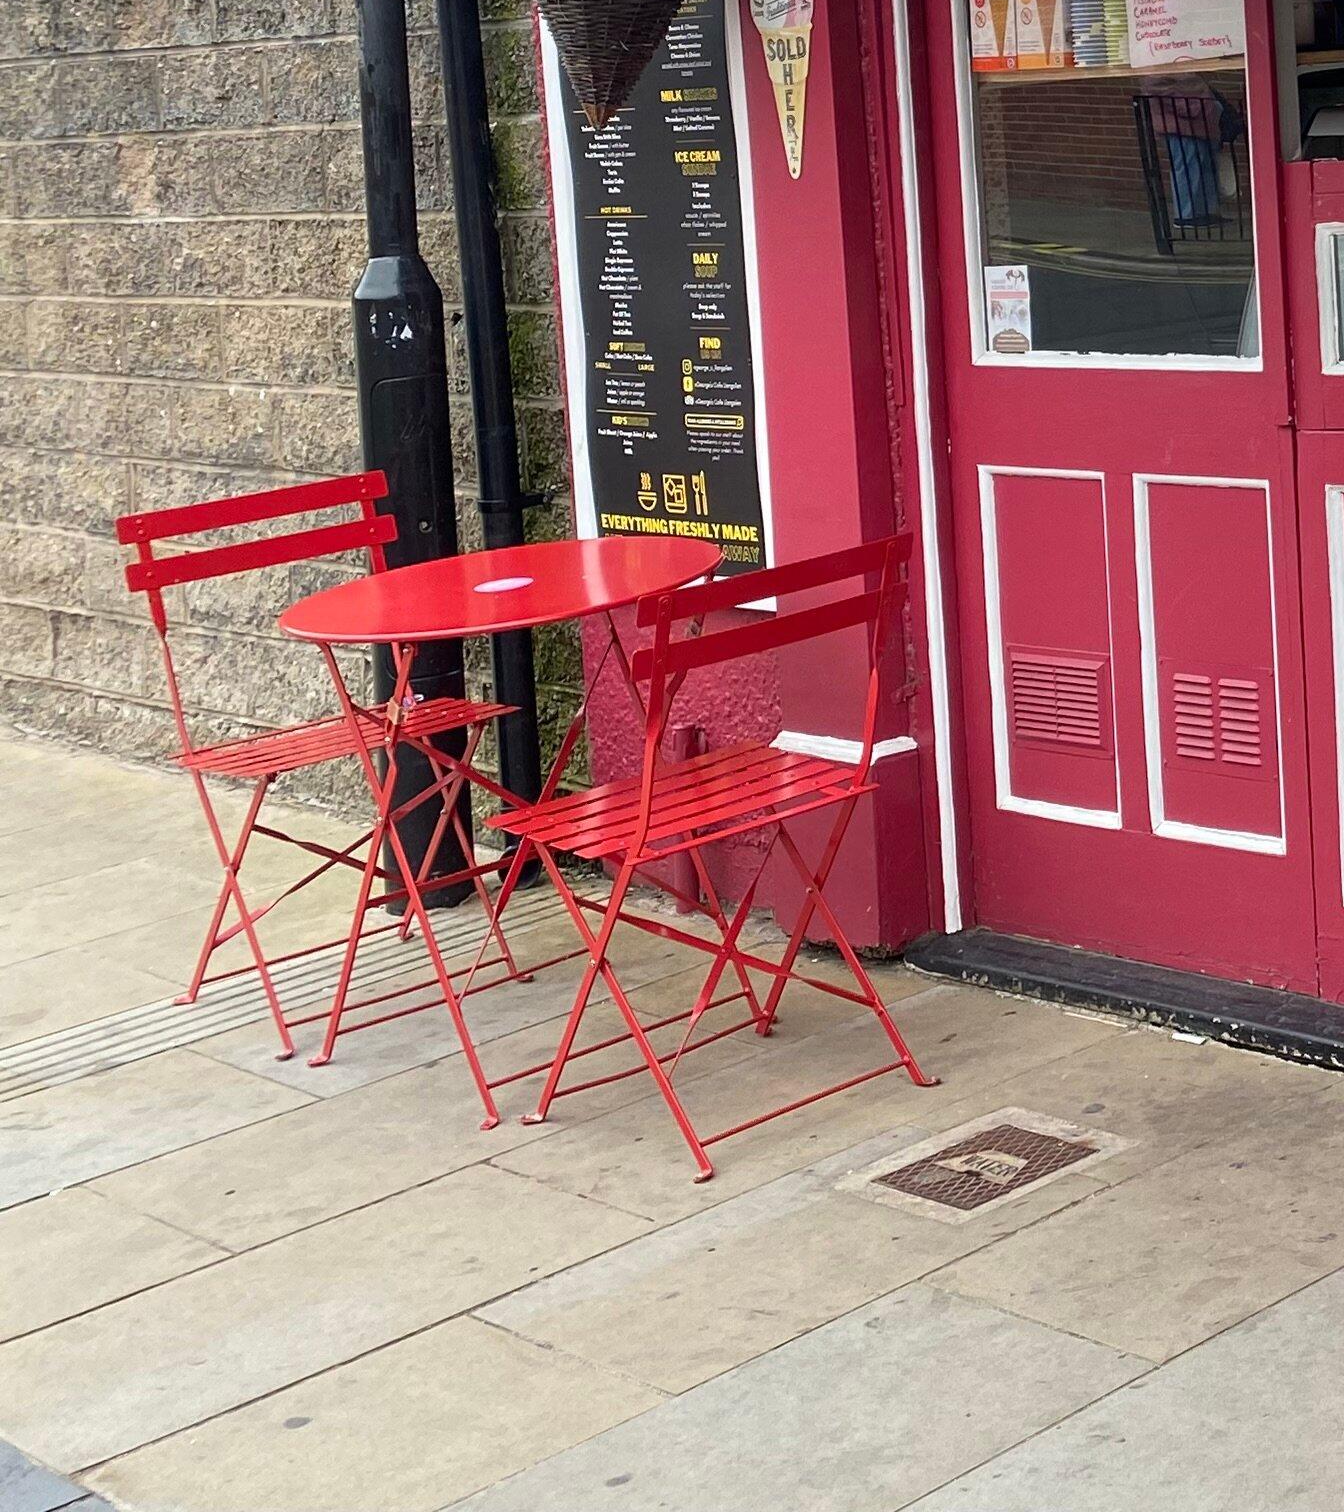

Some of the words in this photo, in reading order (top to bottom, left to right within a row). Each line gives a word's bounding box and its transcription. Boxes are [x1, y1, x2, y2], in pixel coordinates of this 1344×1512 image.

[1133, 6, 1167, 18] CARAMEL
[767, 36, 806, 62] SOLD
[660, 89, 682, 102] MILK
[674, 151, 689, 163] ICE
[690, 150, 721, 163] CREAM
[692, 253, 718, 264] DAILY
[699, 337, 721, 349] FIND
[601, 513, 668, 535] EVERYTHING
[669, 520, 720, 539] FRESHLY
[722, 524, 759, 542] MADE
[960, 1155, 1019, 1177] WATER
